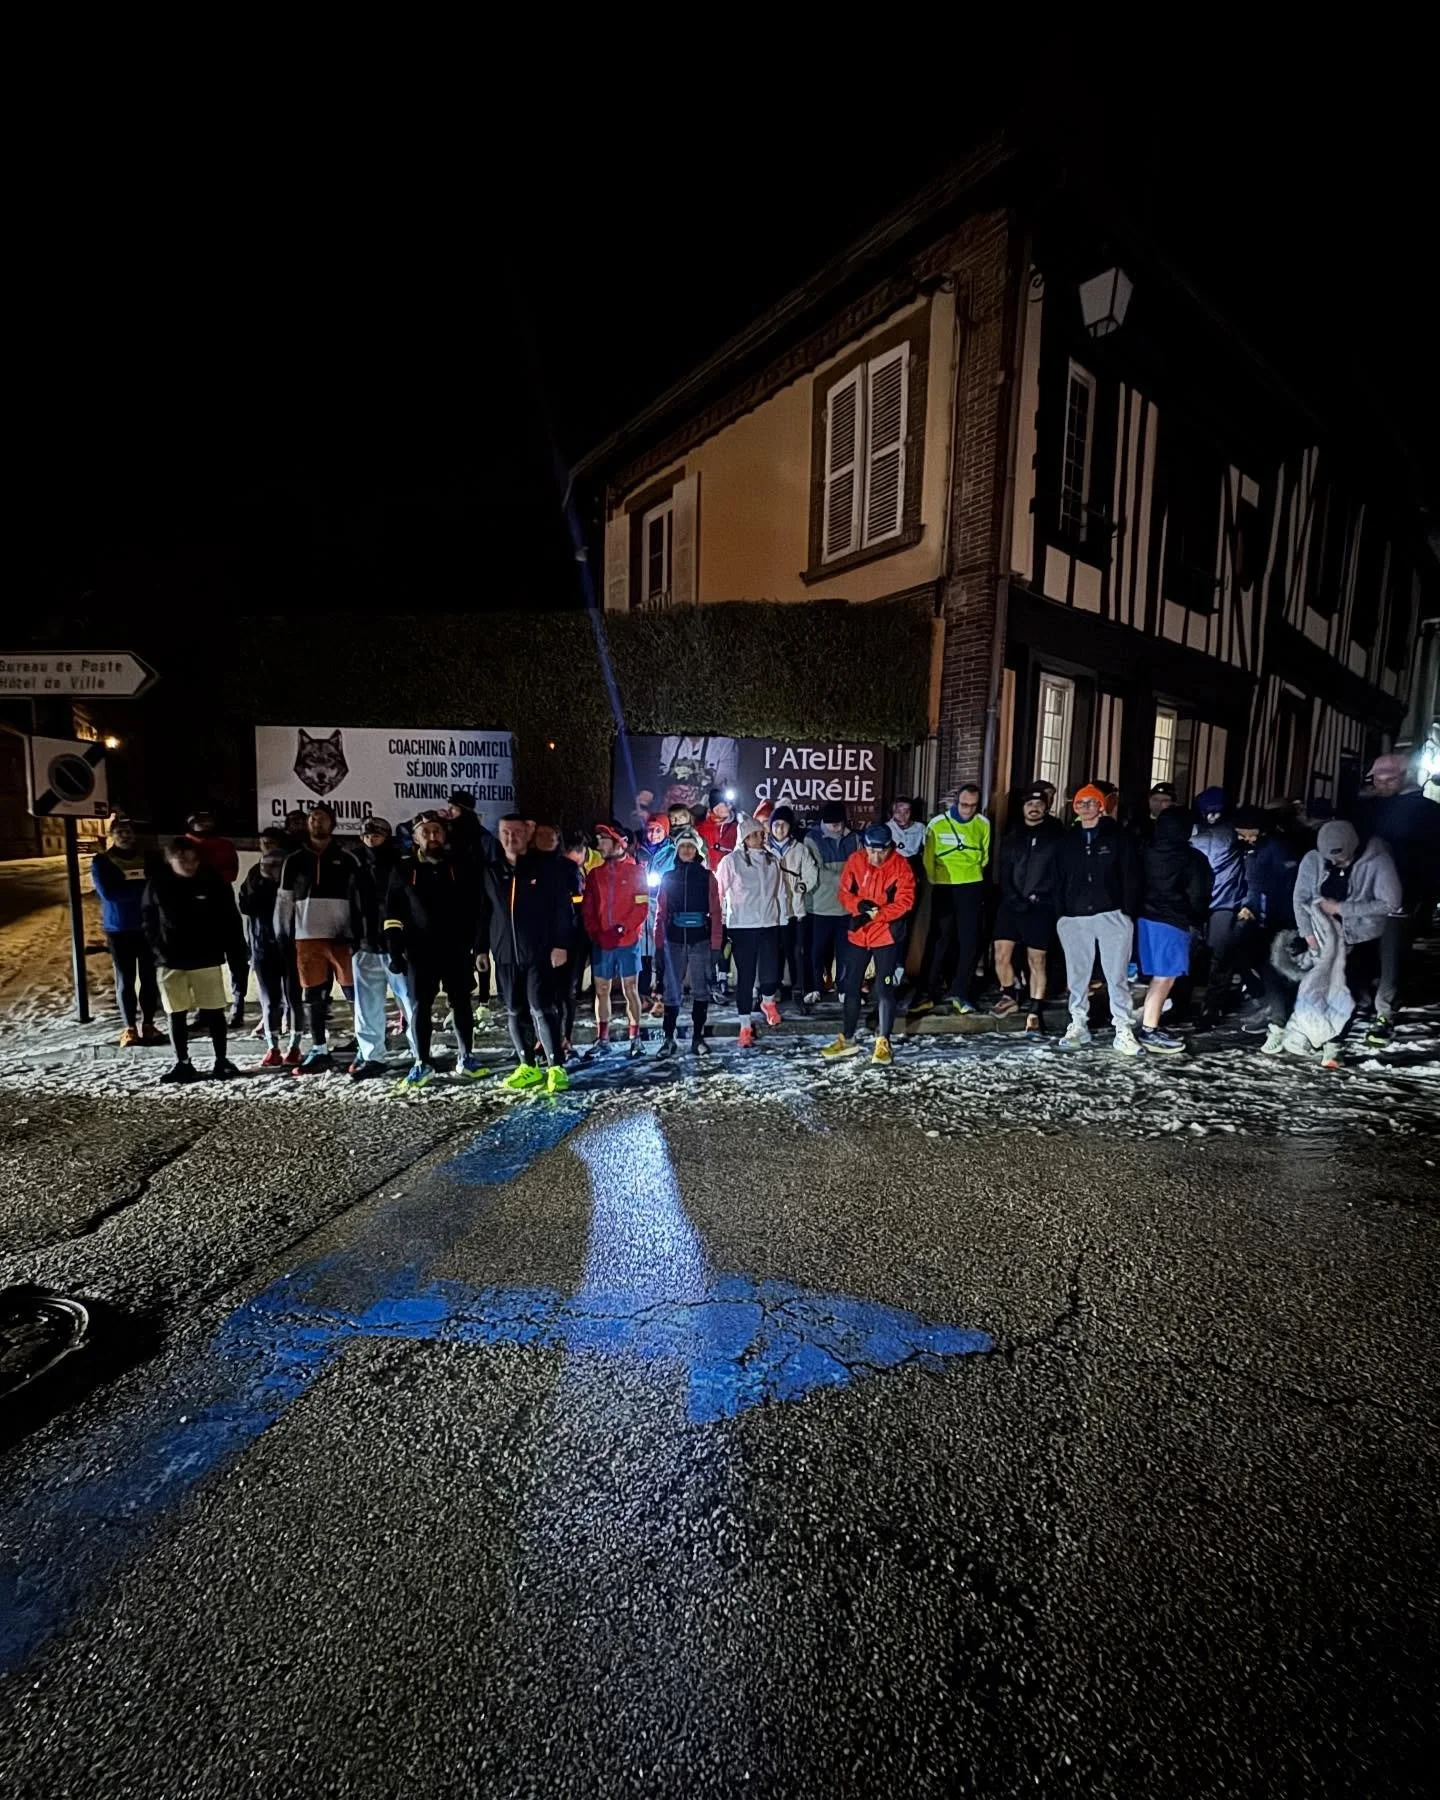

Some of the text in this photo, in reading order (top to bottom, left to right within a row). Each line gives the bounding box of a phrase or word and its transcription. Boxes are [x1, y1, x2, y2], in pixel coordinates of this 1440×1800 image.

[56, 662, 72, 673] de
[82, 659, 122, 673] Poste
[45, 679, 61, 689] de
[71, 676, 105, 689] Ville
[389, 737, 513, 758] COACHING À DOMICIL
[407, 759, 500, 780] SÉJOUR SPORTIF
[394, 783, 448, 800] TRAINING
[272, 799, 287, 817] CL
[791, 803, 820, 813] TISAN
